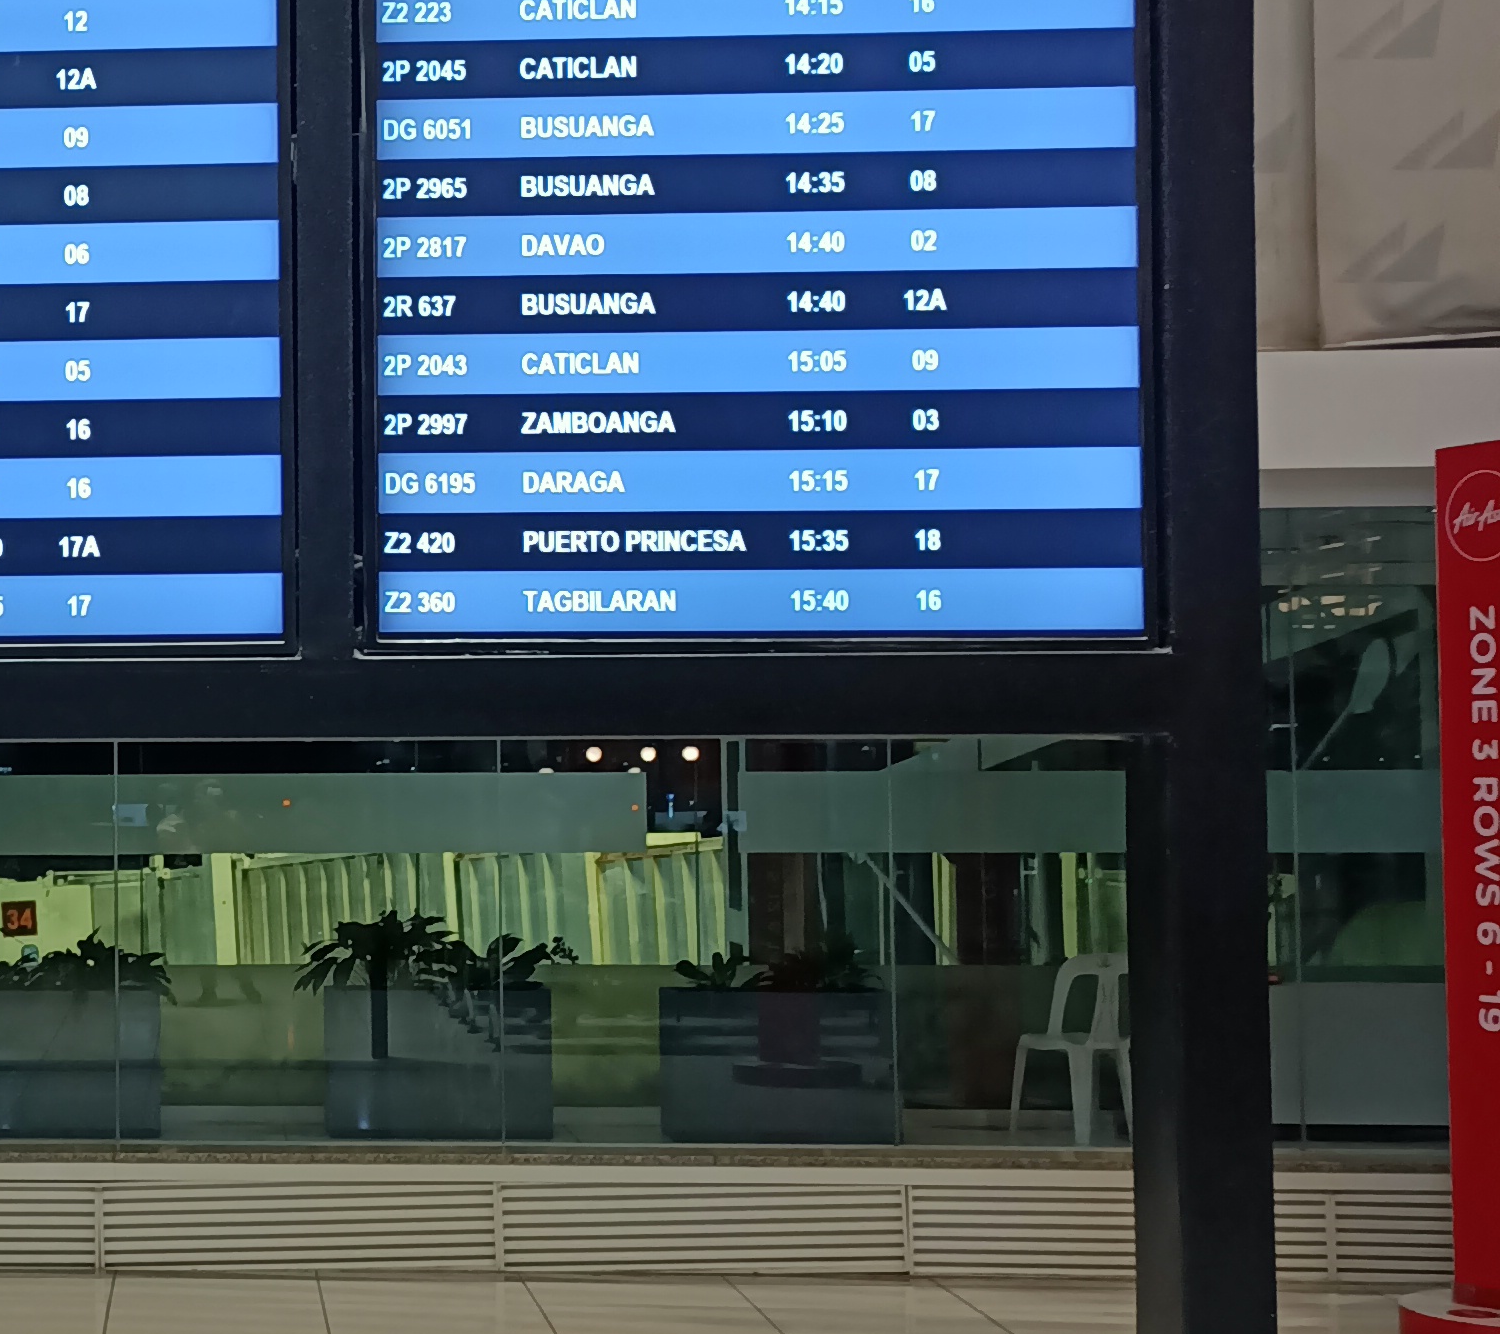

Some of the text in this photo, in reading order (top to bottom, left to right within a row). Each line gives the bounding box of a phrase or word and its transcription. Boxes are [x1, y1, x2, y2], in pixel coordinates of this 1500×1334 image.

[63, 184, 90, 207] 08
[65, 301, 90, 323] 17
[383, 288, 948, 318] 2R 637 BUSUANGA 14:40 12A
[384, 408, 940, 436] 2P 2997 ZAMBOANGA 15:10 03
[58, 534, 101, 558] 17A
[384, 589, 942, 613] Z2 360 TAGBILARAN 15:40 16
[1469, 605, 1499, 723] ZONE
[1471, 738, 1500, 761] 3
[1472, 776, 1500, 907] ROWS
[6, 907, 33, 930] 34
[1476, 921, 1500, 946] 6
[1478, 990, 1500, 1033] 19
